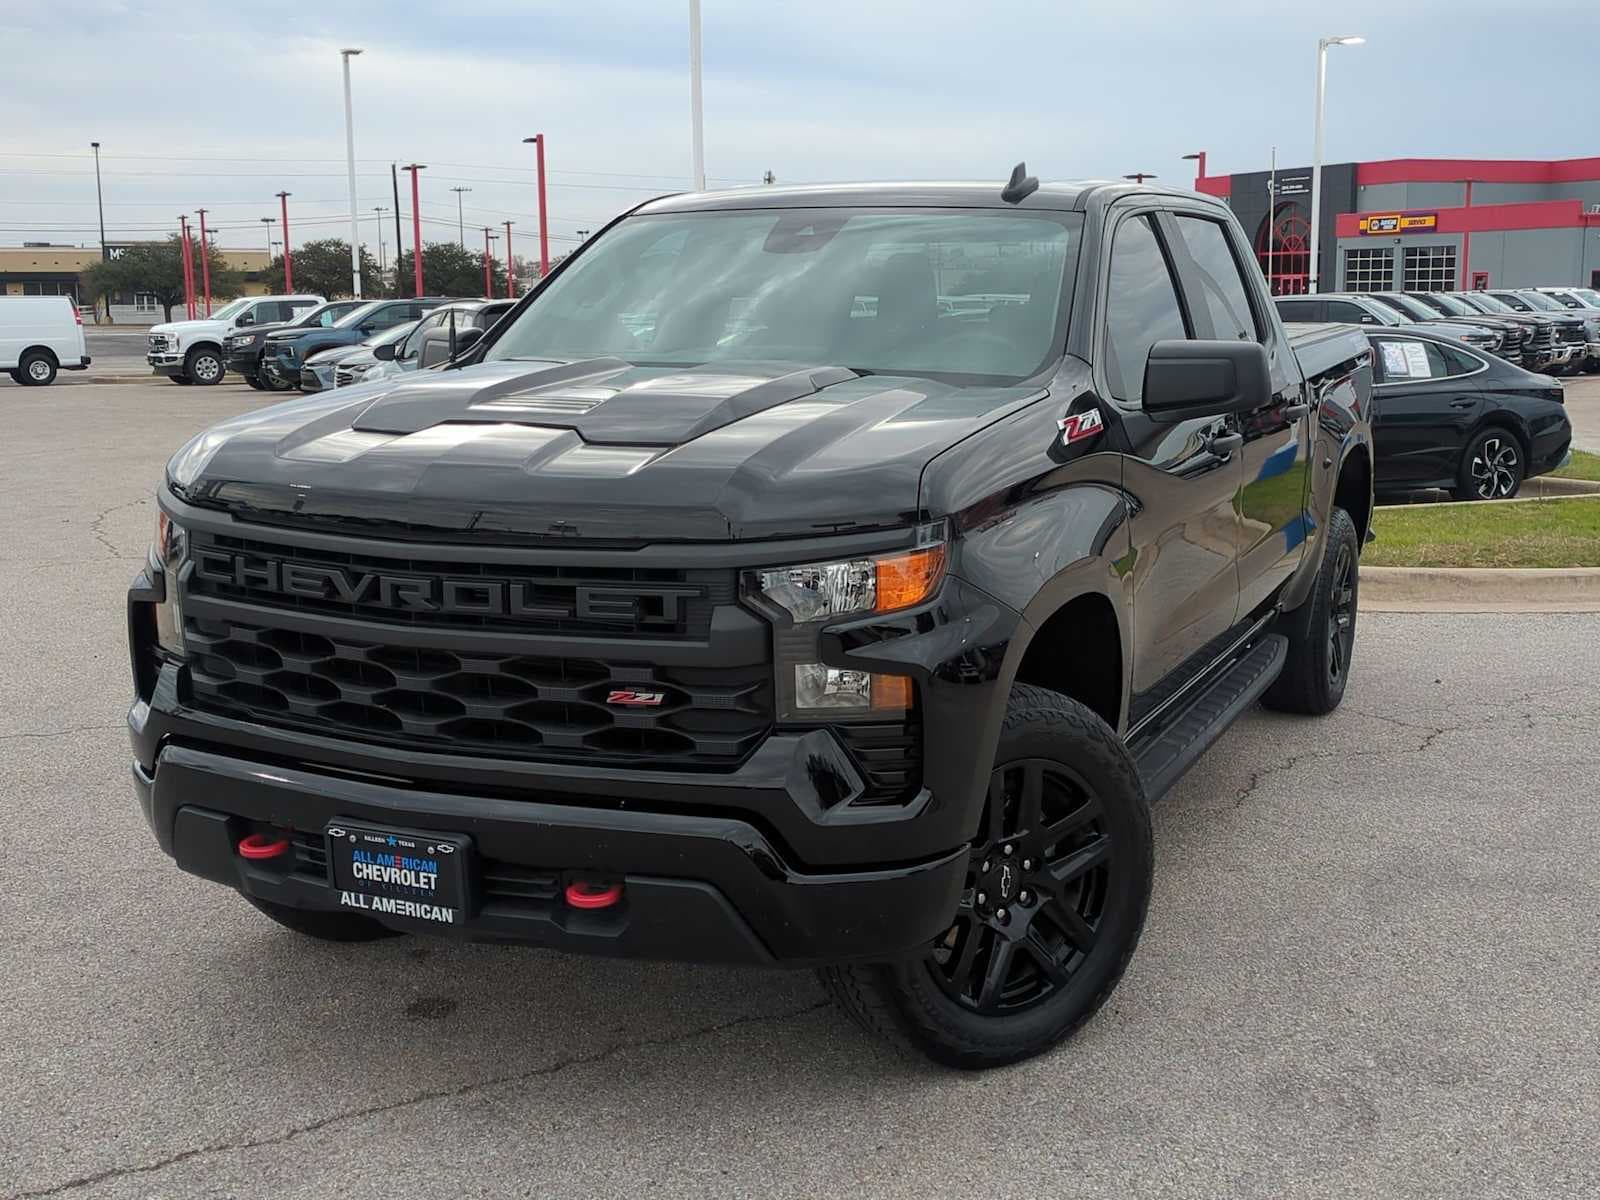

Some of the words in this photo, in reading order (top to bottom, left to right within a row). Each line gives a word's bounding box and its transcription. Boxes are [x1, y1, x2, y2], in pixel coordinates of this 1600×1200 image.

[1056, 408, 1104, 446] Z71
[191, 547, 703, 625] CHEVROLET
[398, 840, 415, 848] TEXAS
[352, 850, 374, 863] ALL
[376, 853, 438, 873] AMERICAN
[352, 862, 438, 890] CHEVROLET
[341, 891, 369, 909] ALL
[371, 896, 454, 923] AMERICAN
